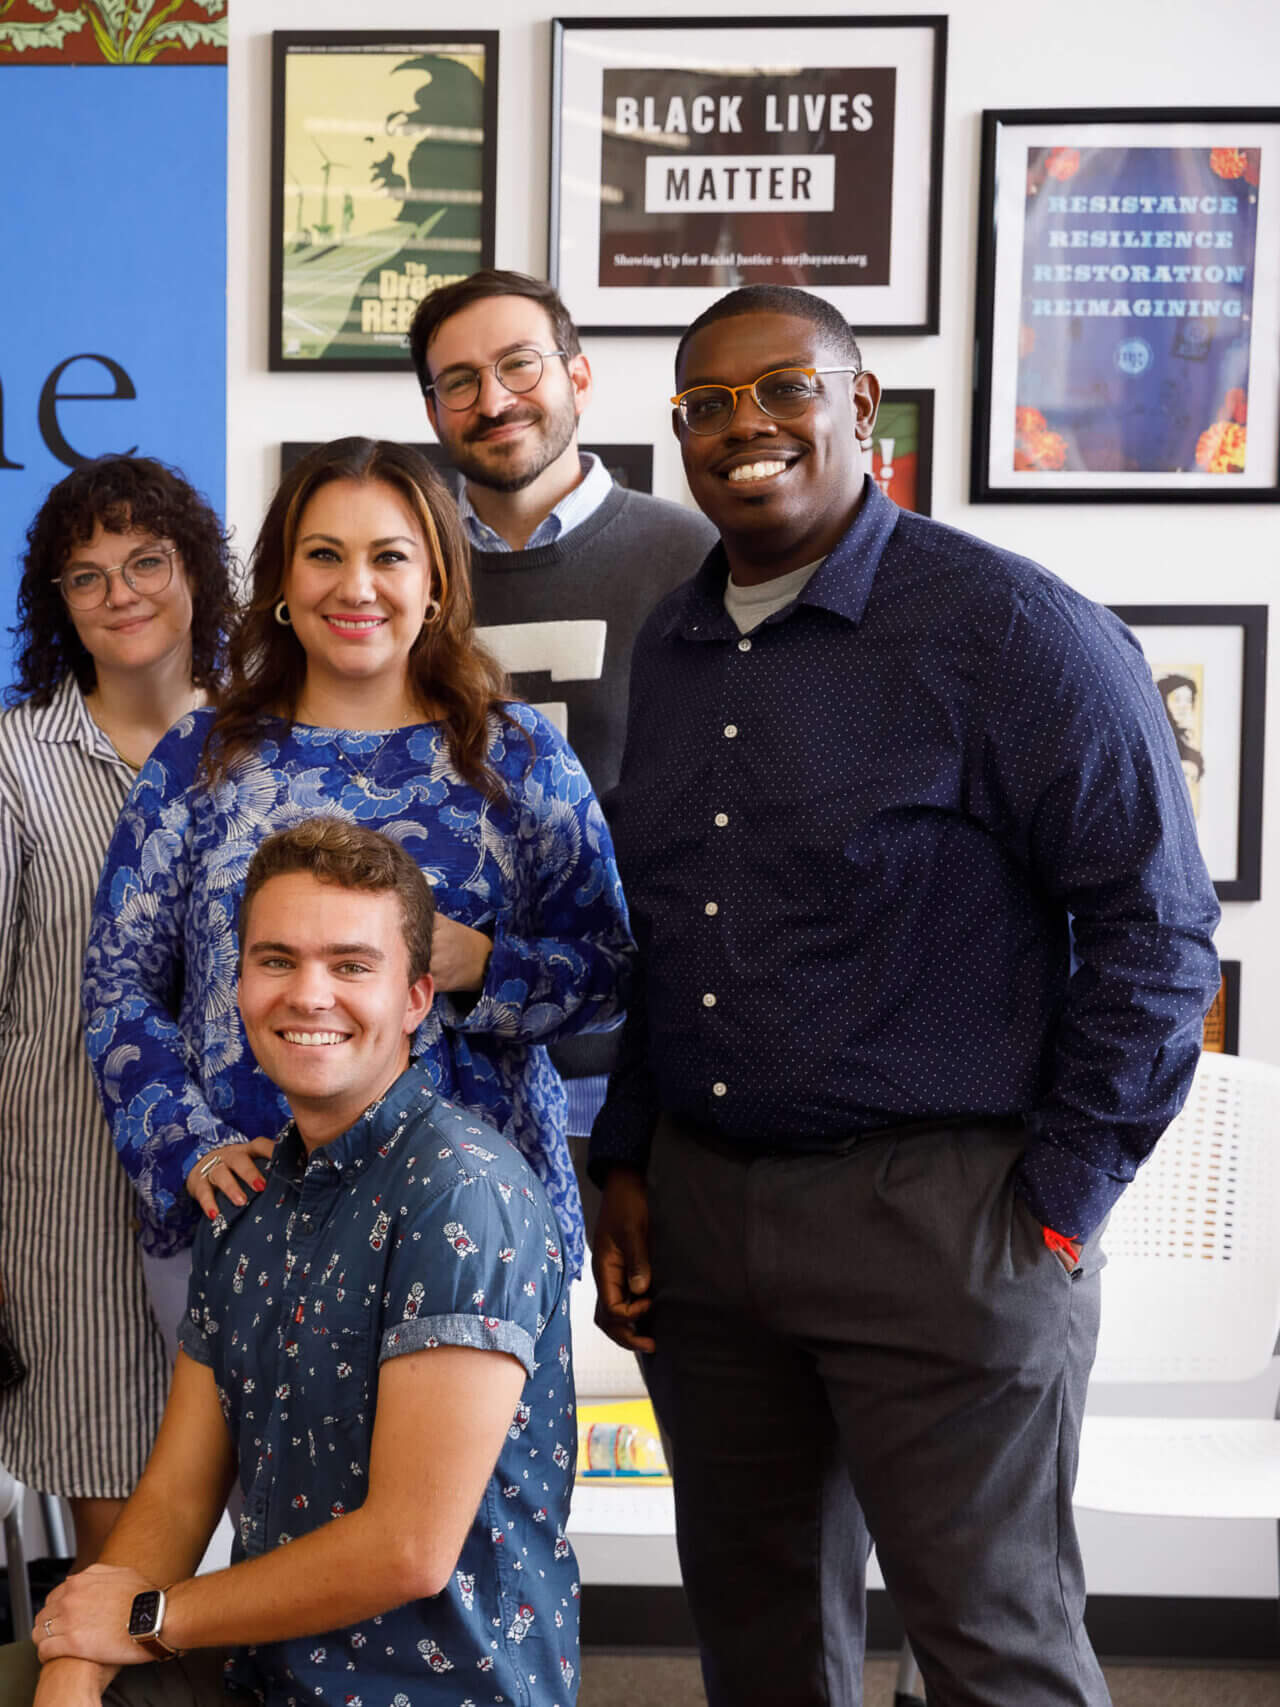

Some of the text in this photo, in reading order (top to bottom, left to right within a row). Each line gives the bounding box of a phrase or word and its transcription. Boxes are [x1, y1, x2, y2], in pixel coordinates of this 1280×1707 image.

[614, 94, 874, 134] BLACK LIVES
[665, 167, 813, 201] MATTER
[1047, 195, 1239, 215] RESISTANCE
[1048, 230, 1234, 249] RESILIENCE
[404, 262, 428, 276] The
[613, 253, 662, 269] Showing
[663, 253, 680, 269] Up
[681, 253, 699, 266] for
[701, 253, 735, 267] Racial
[736, 253, 773, 267] Justice
[1032, 264, 1247, 284] RESTORATION
[361, 299, 417, 334] REB
[1031, 299, 1242, 318] REIMAGINING
